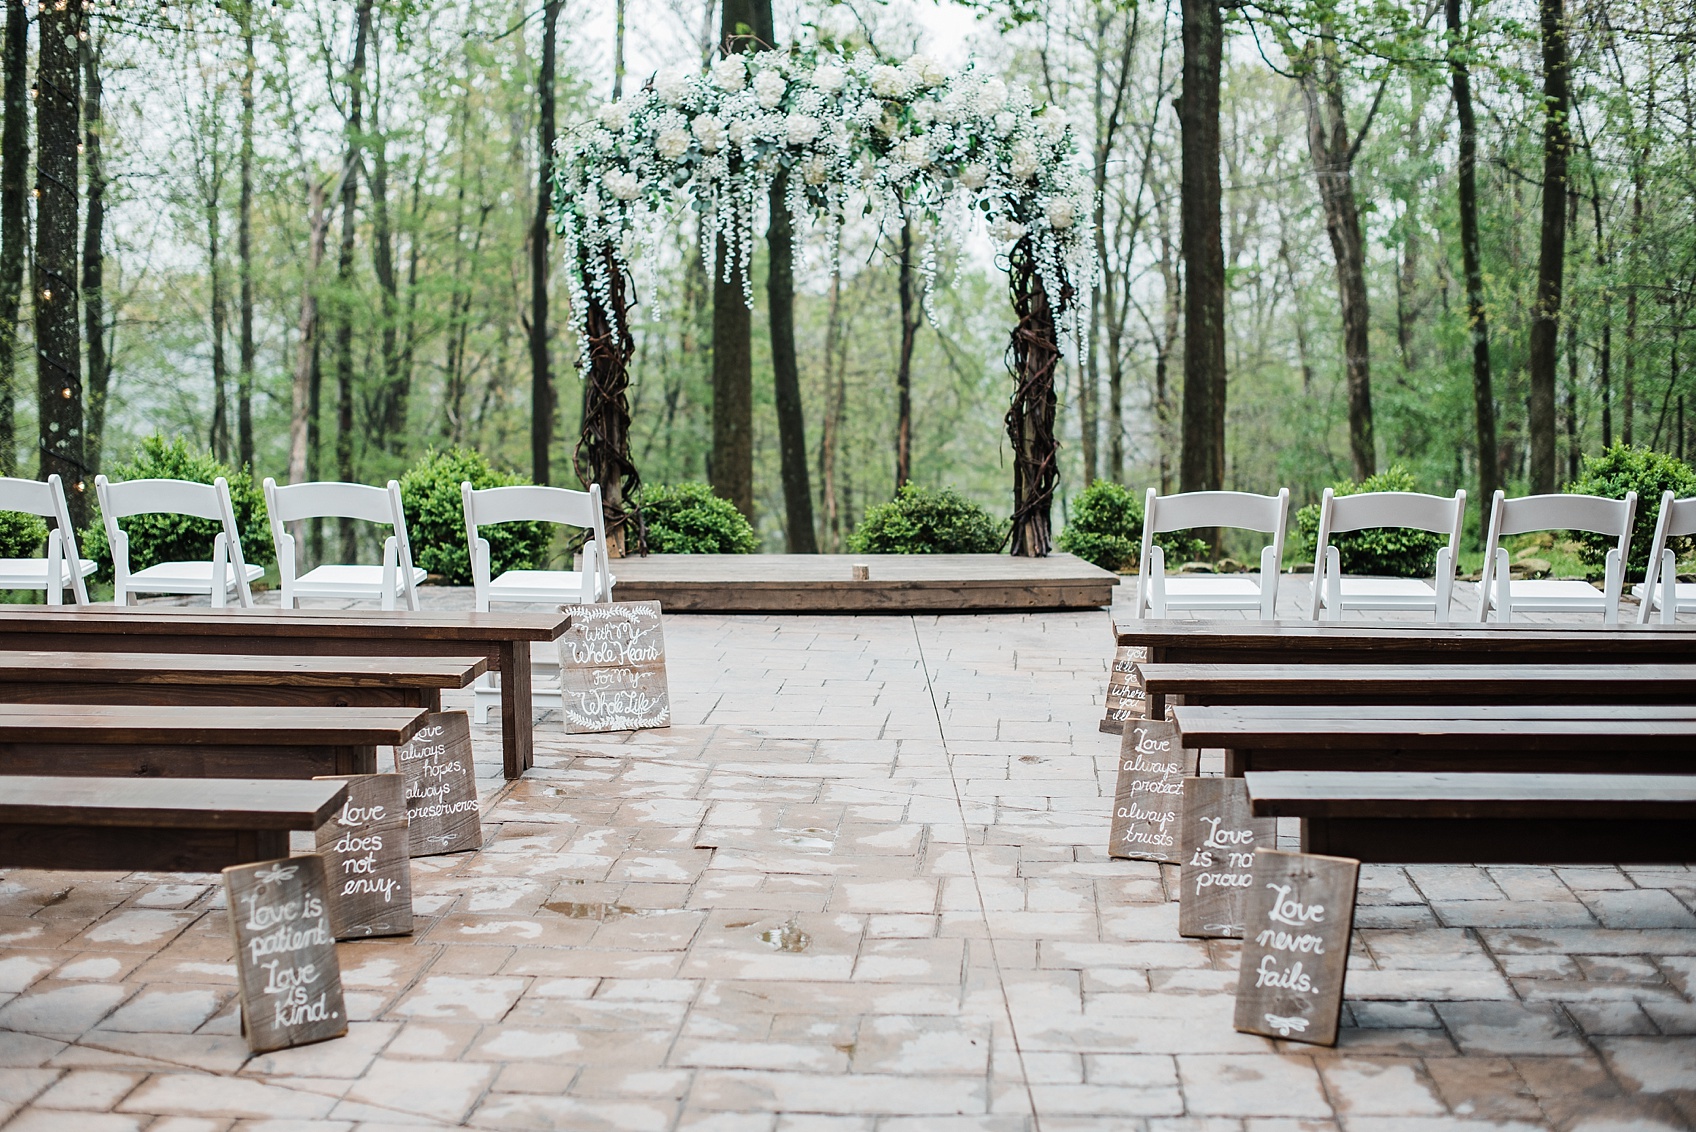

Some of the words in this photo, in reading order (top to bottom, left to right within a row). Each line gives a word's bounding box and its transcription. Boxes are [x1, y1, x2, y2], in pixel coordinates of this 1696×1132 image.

[571, 622, 614, 642] With
[609, 622, 659, 644] My
[564, 639, 616, 664] Whole
[608, 639, 662, 667] Heart
[592, 668, 615, 685] For
[611, 668, 655, 688] My
[567, 685, 623, 716] Whole
[621, 690, 665, 717] Life
[1119, 698, 1140, 710] you
[401, 743, 446, 764] always
[1133, 727, 1170, 754] Love
[423, 758, 467, 782] hopes,
[1123, 754, 1178, 781] always
[405, 781, 451, 803] always
[1130, 779, 1184, 797] protect
[338, 796, 387, 826] Love
[1117, 802, 1176, 831] always
[334, 831, 383, 853] does
[1122, 823, 1174, 846] trusts
[1200, 816, 1255, 849] Love
[342, 851, 377, 874] not
[1190, 847, 1213, 867] is
[1229, 851, 1255, 868] no
[340, 877, 401, 902] envy.
[241, 893, 300, 931] Love
[301, 892, 323, 918] is
[1266, 882, 1325, 926] Love
[248, 918, 336, 965] patient.
[1255, 929, 1325, 955] never
[260, 958, 321, 994] Love
[1255, 954, 1319, 994] fails.
[286, 985, 309, 1006] is
[274, 993, 339, 1029] kind.
